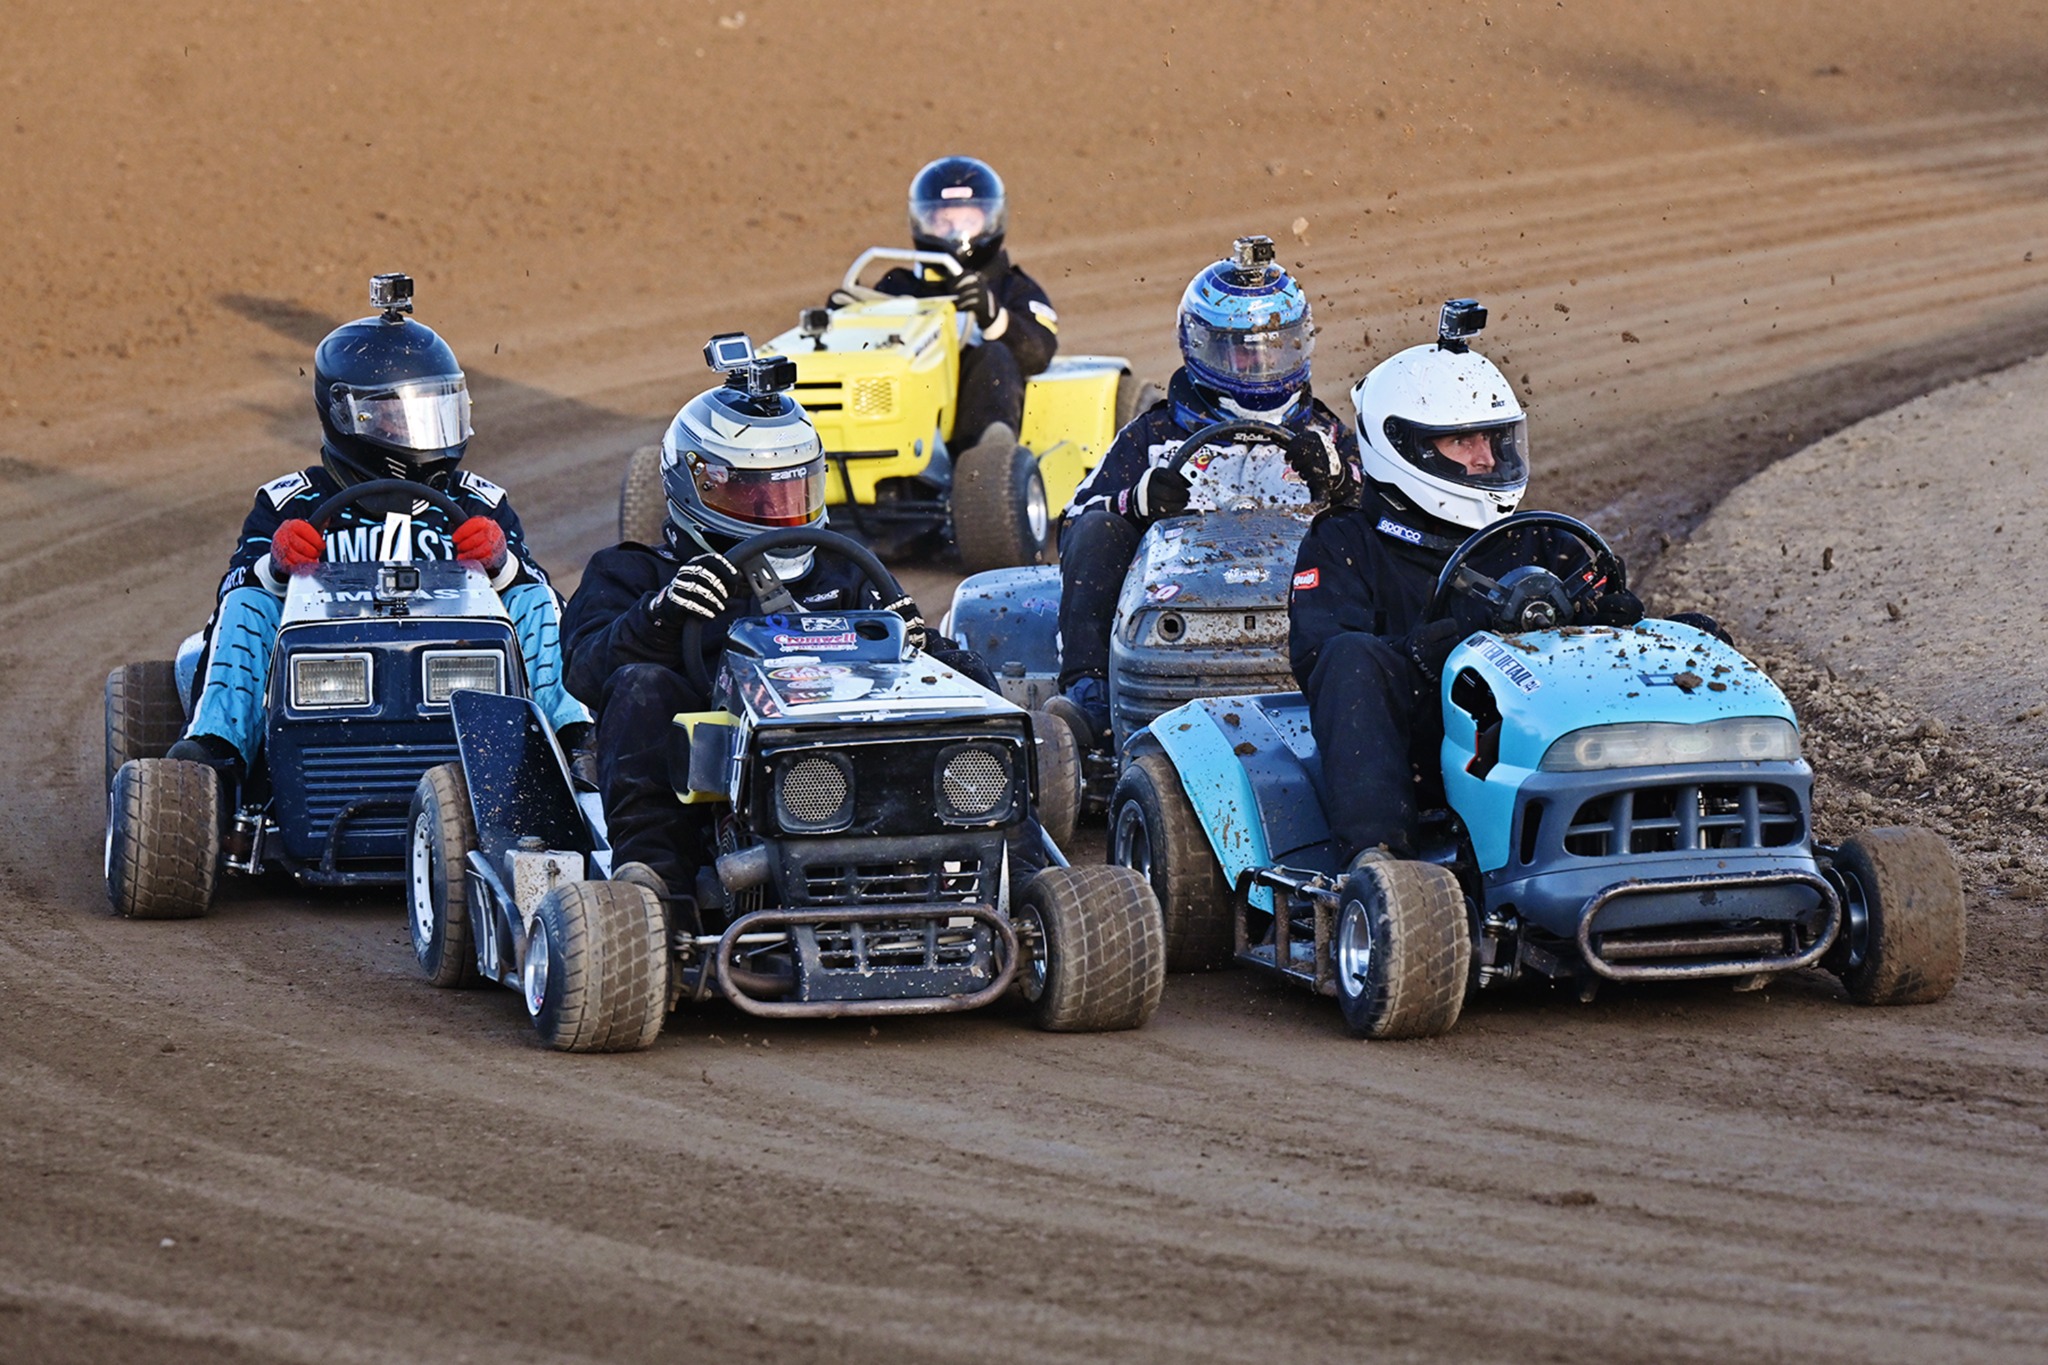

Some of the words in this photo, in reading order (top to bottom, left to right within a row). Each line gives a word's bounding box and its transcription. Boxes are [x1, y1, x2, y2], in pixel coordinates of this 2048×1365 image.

[771, 467, 807, 481] zamp
[1381, 519, 1421, 542] sparco
[295, 588, 487, 603] TIMAST
[774, 632, 857, 645] Cromwell
[1495, 654, 1533, 687] DETAIL
